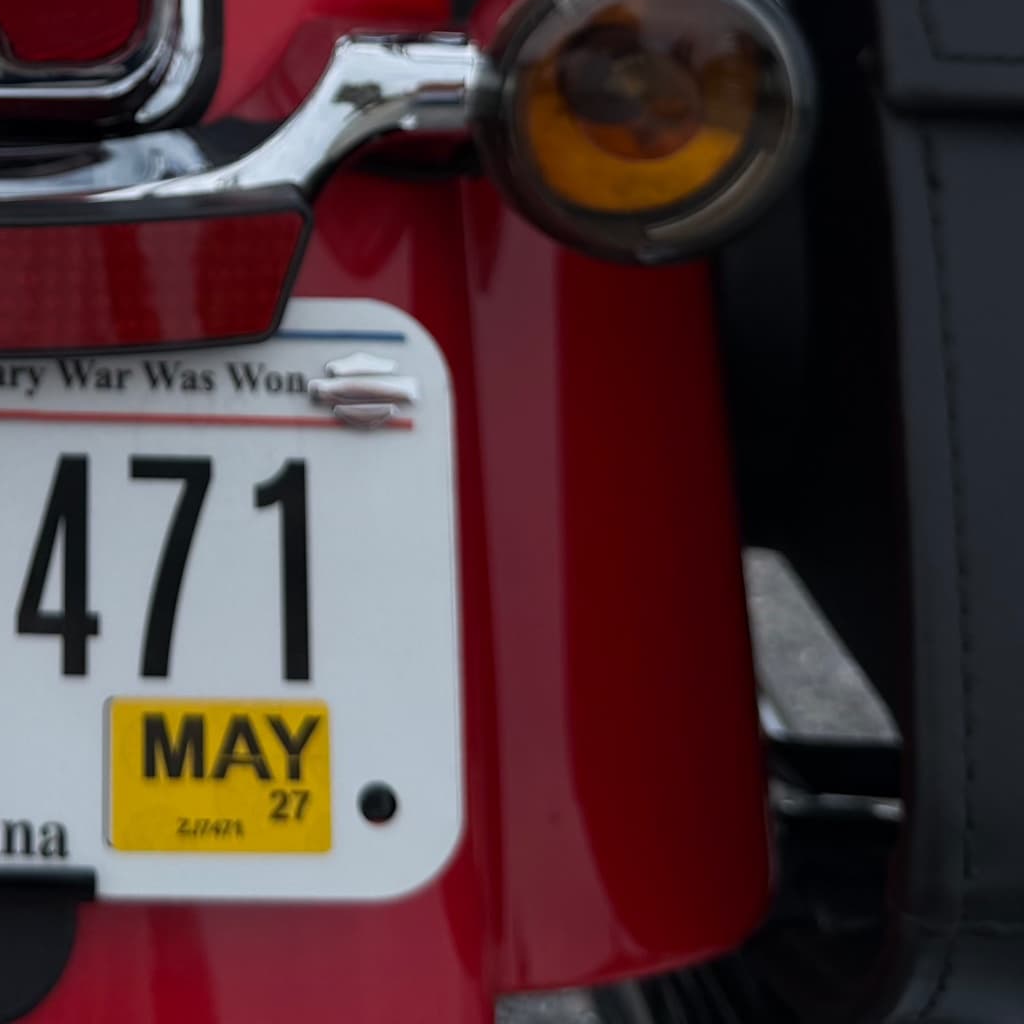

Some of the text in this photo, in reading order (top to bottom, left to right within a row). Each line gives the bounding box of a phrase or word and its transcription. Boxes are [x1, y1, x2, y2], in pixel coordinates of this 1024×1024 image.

[56, 358, 130, 391] War
[142, 360, 215, 393] Was
[226, 361, 308, 394] Won
[142, 712, 322, 782] MAY
[269, 789, 311, 822] 27
